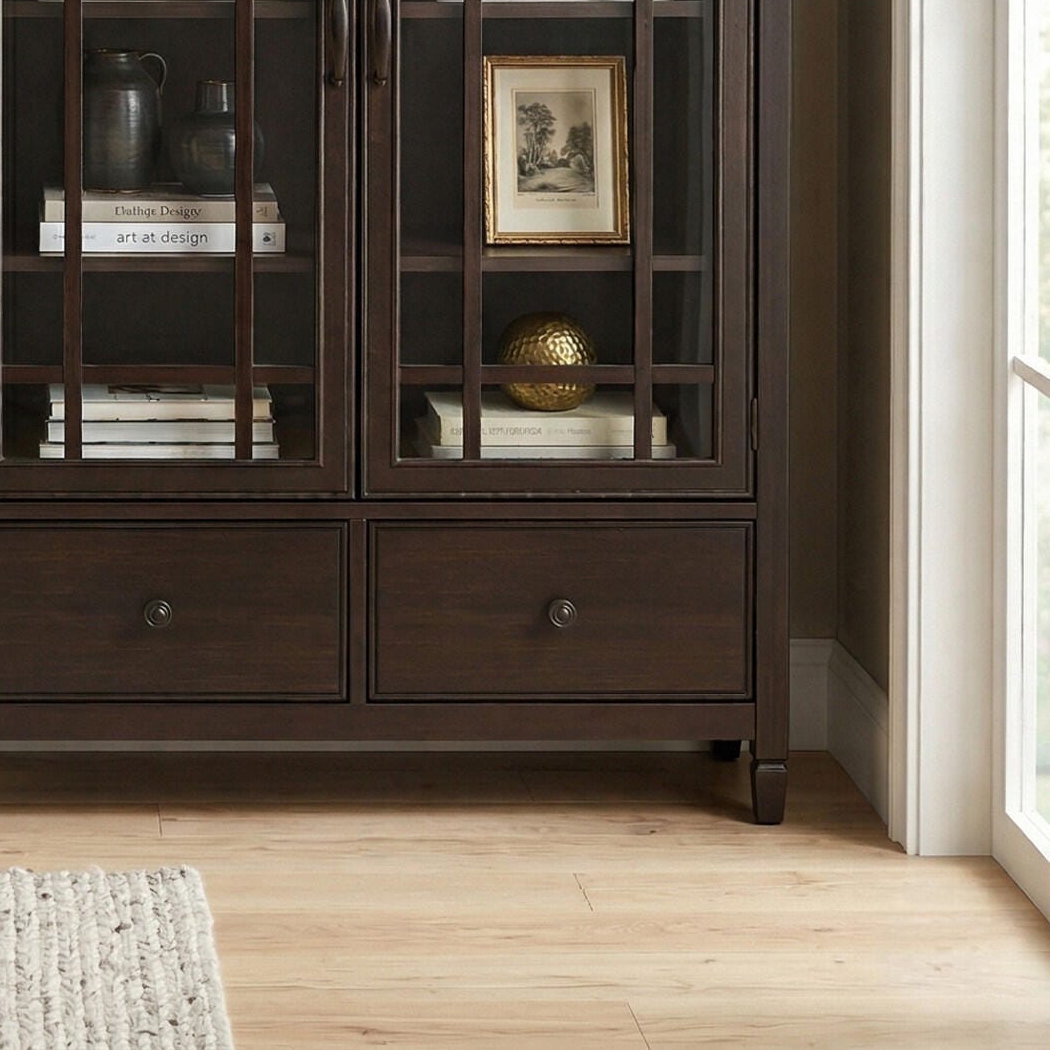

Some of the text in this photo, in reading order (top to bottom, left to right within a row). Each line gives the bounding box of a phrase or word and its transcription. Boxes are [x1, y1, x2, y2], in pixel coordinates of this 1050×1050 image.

[116, 230, 208, 247] art at design
